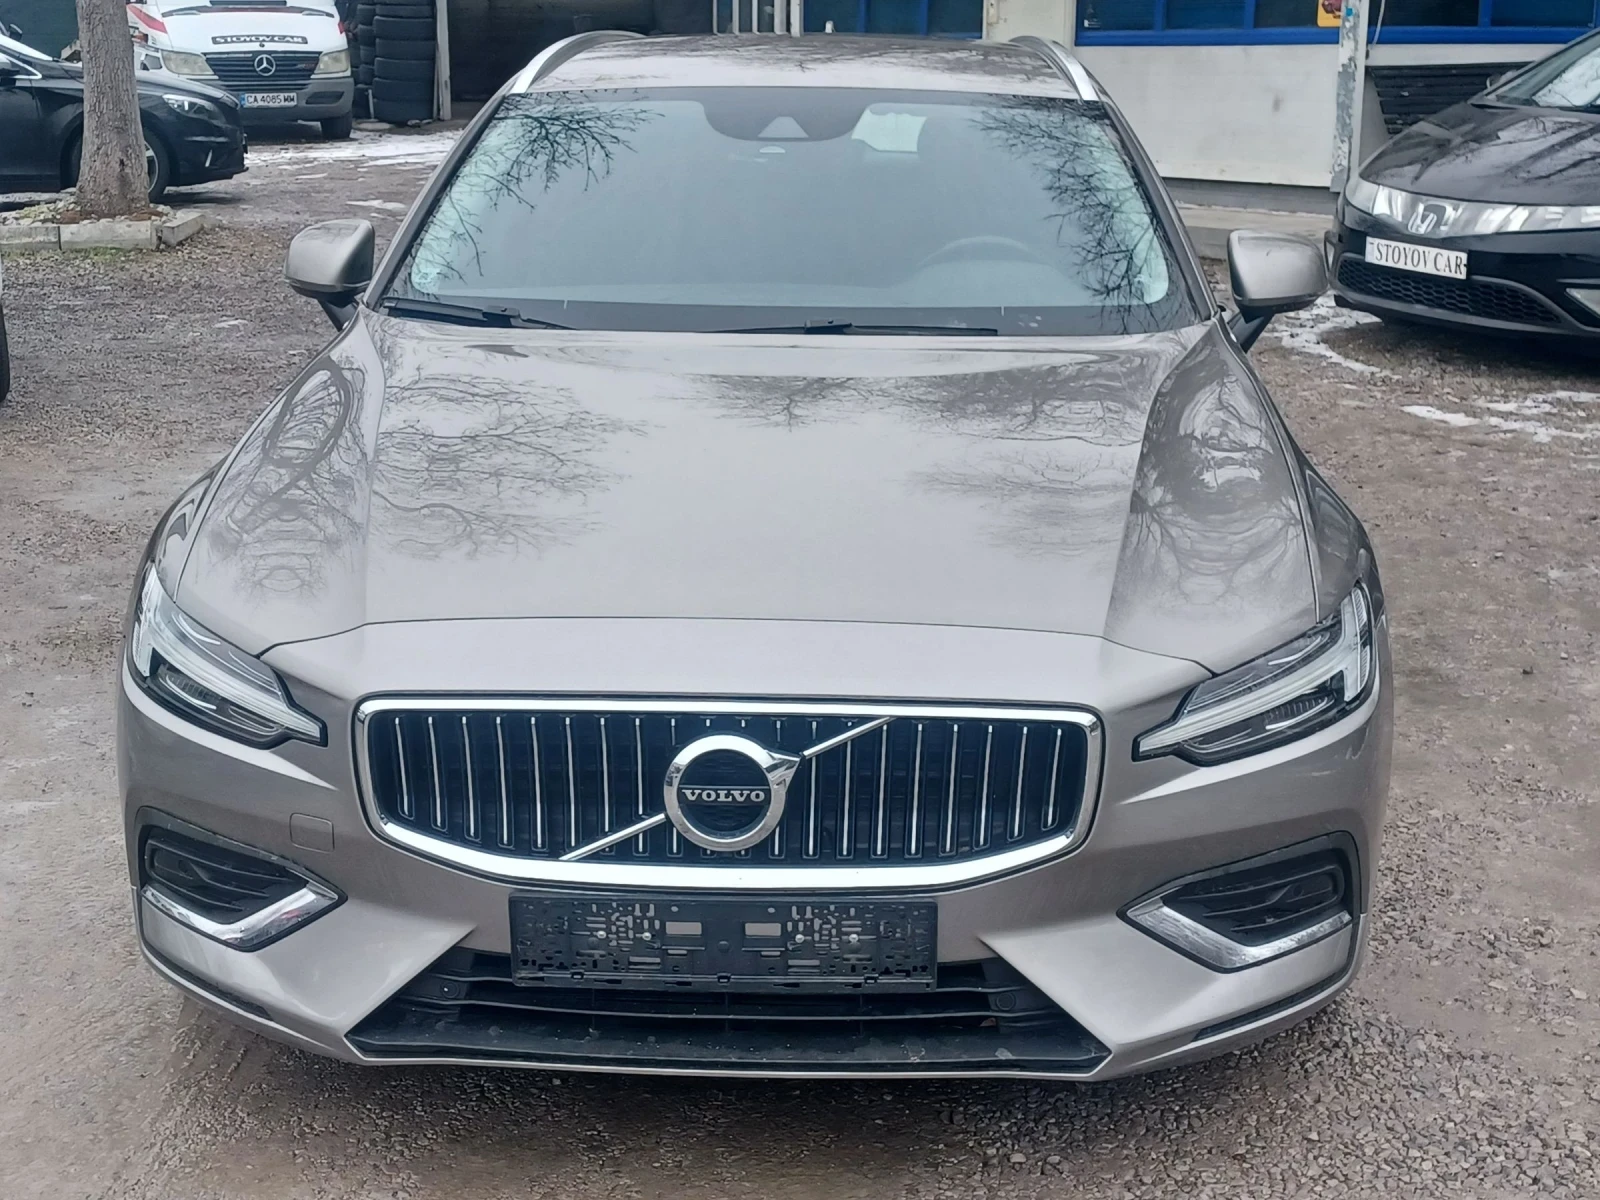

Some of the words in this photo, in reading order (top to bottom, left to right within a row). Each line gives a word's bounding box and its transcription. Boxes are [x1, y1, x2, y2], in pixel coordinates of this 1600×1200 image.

[215, 35, 272, 43] STOYOV
[273, 35, 303, 43] CAR
[246, 94, 259, 105] CA
[260, 94, 282, 104] 4085
[1375, 242, 1431, 269] STOYOV
[1433, 251, 1463, 276] CAR
[682, 789, 765, 802] VOLVO
